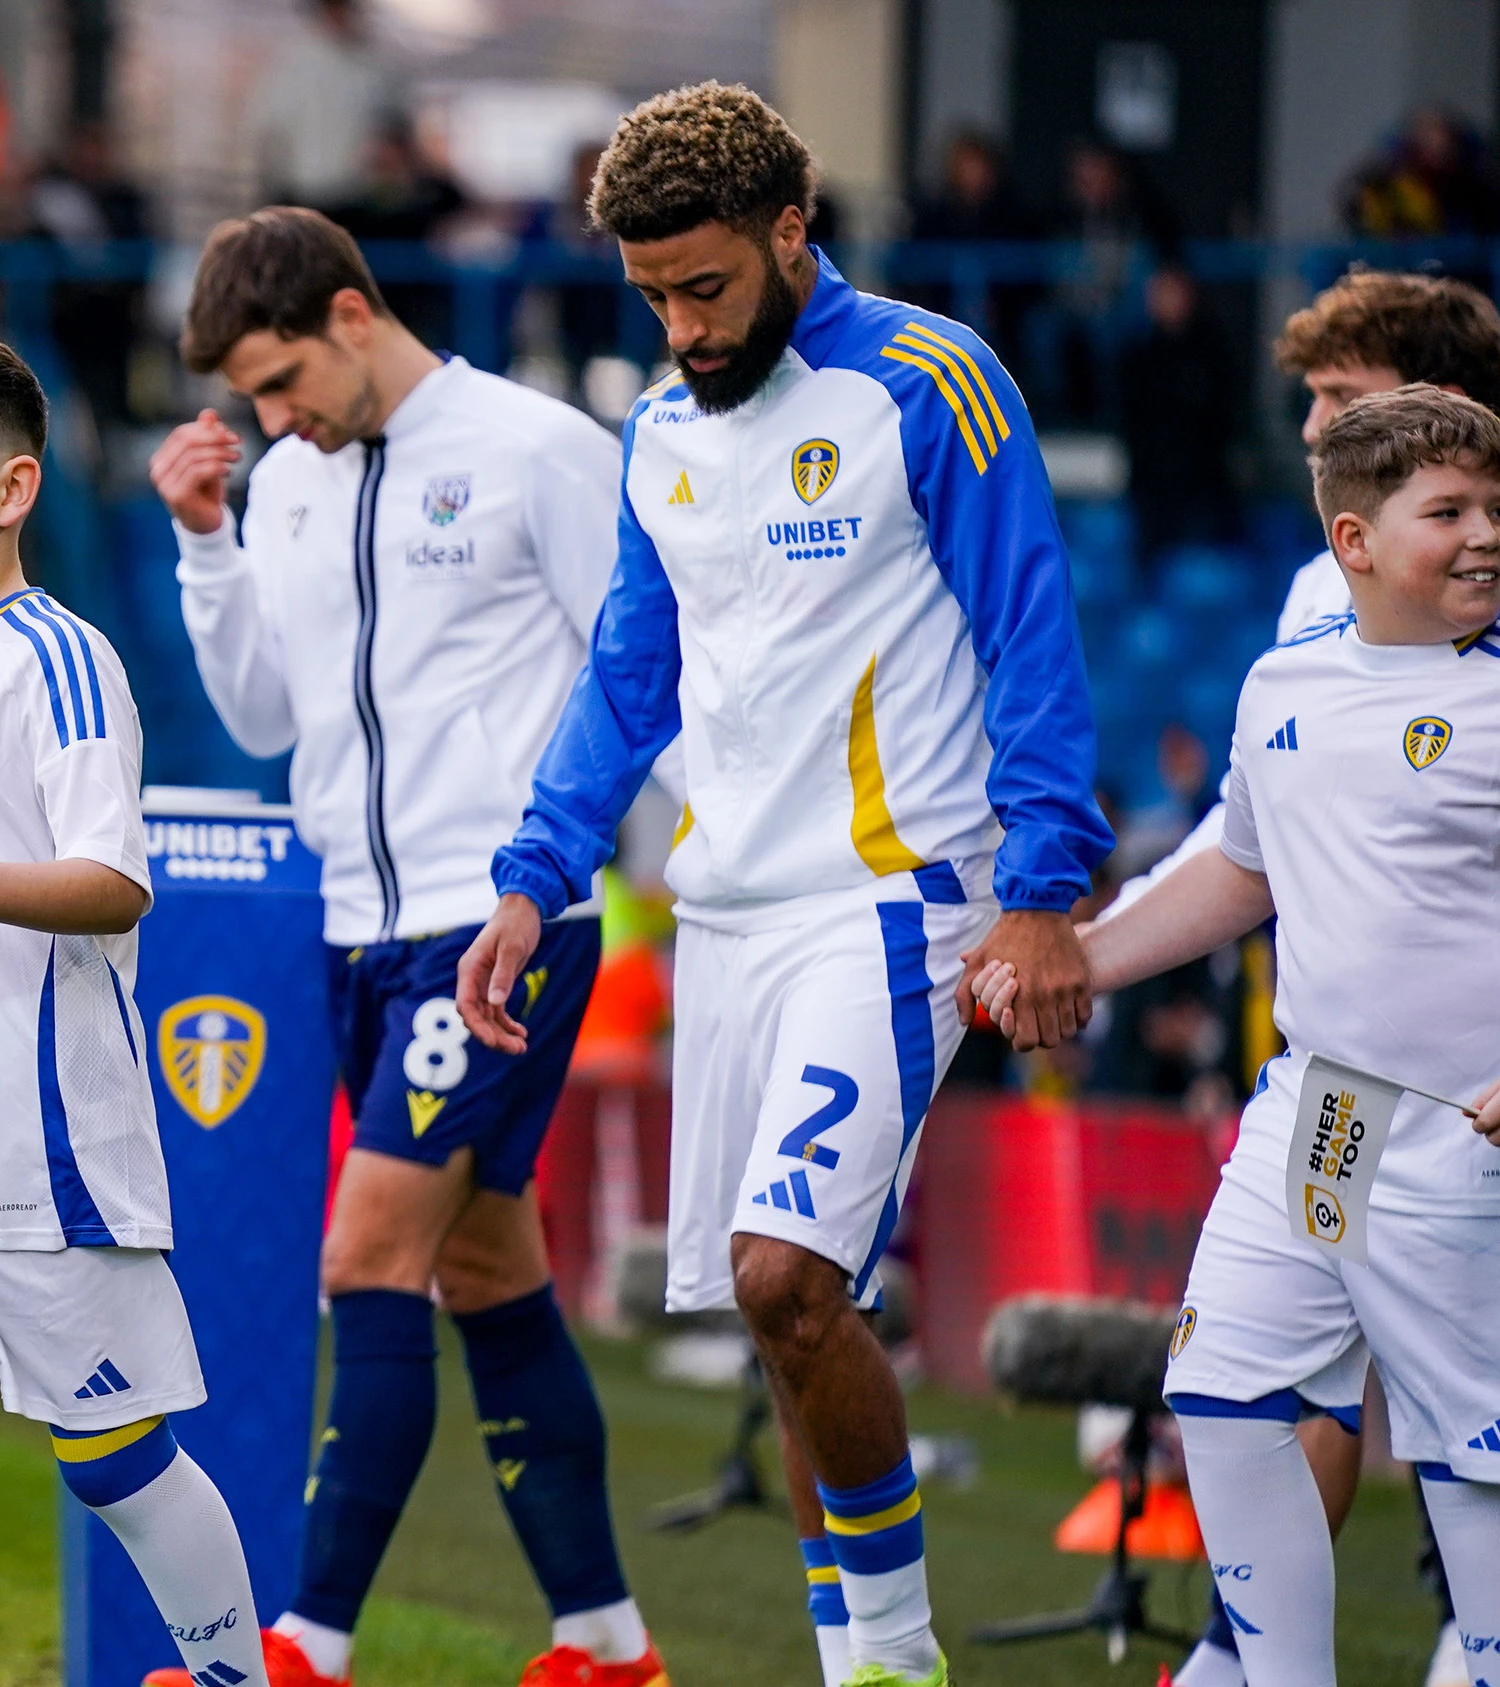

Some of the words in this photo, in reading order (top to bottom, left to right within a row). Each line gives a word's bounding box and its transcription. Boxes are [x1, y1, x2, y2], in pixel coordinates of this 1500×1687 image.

[653, 407, 706, 424] UNIB
[405, 538, 475, 566] ideal
[766, 517, 862, 546] UNIBET
[143, 821, 294, 862] UNIBET
[403, 997, 471, 1091] 8
[777, 1064, 859, 1170] 2
[1309, 1092, 1339, 1173] #HER
[1323, 1090, 1356, 1177] GAME
[1337, 1120, 1365, 1181] TOO
